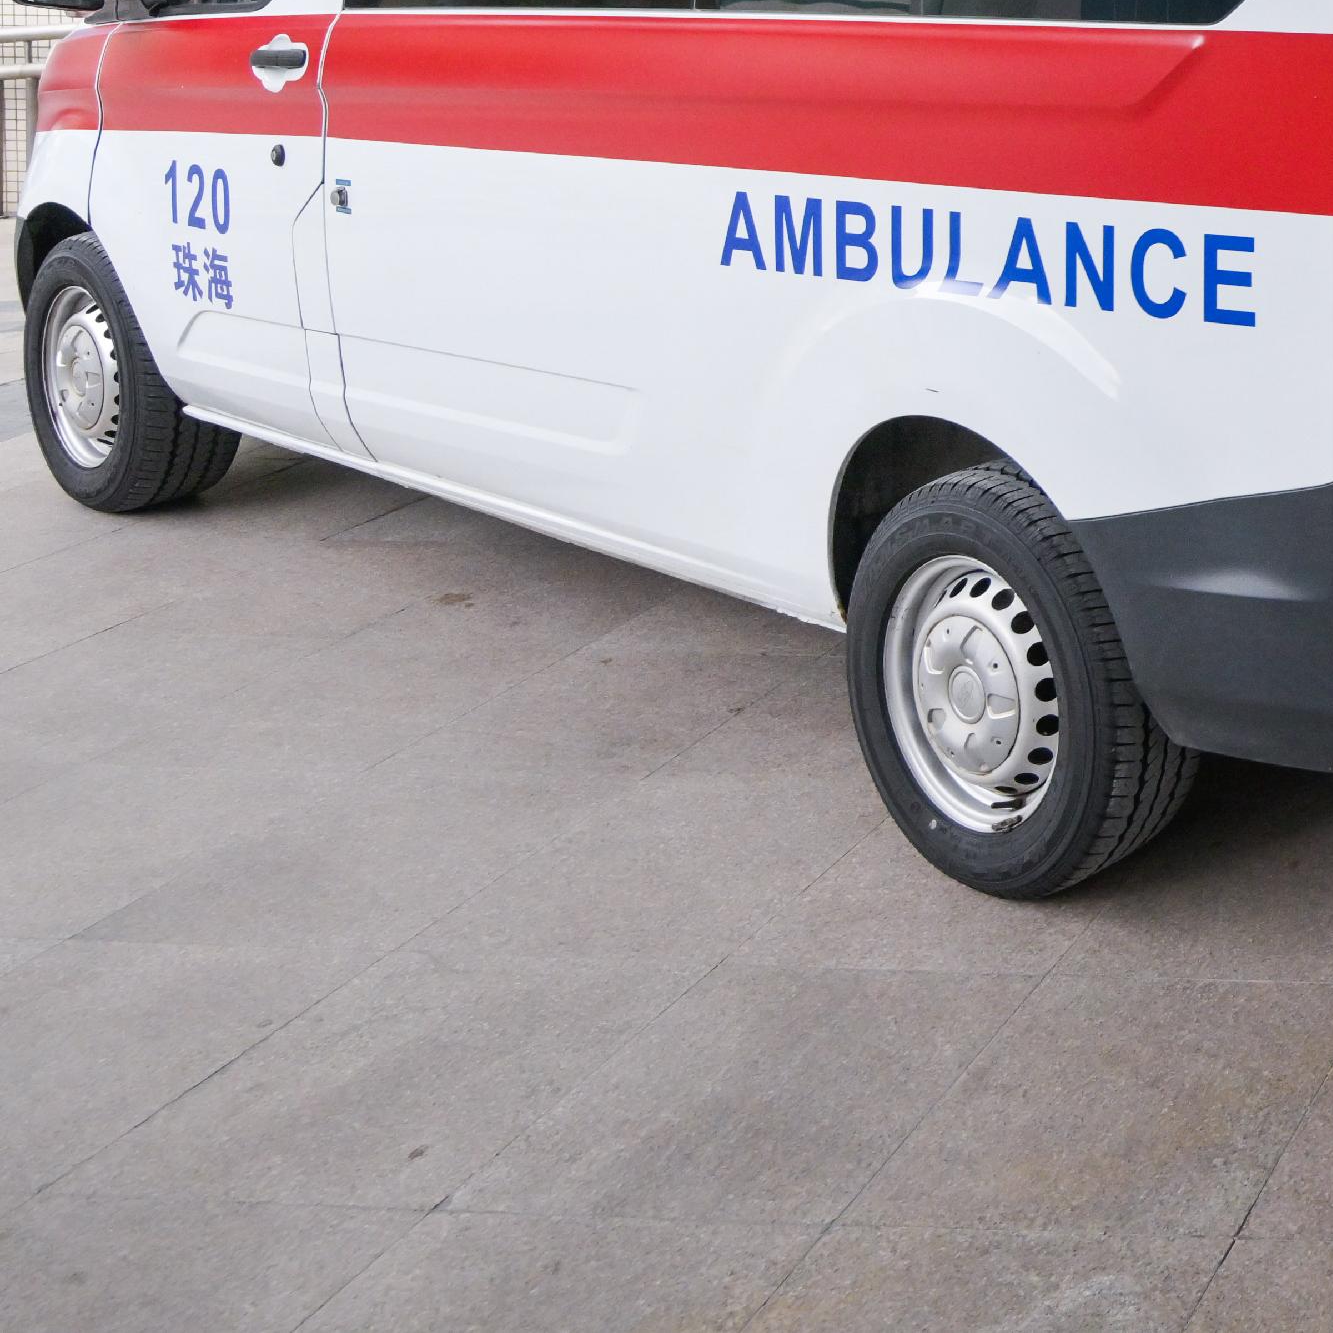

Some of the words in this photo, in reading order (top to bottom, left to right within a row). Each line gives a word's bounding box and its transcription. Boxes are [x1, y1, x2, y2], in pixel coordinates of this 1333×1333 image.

[164, 159, 231, 235] 120
[171, 241, 234, 310] 珠海
[719, 190, 1257, 328] AMBULANCE
